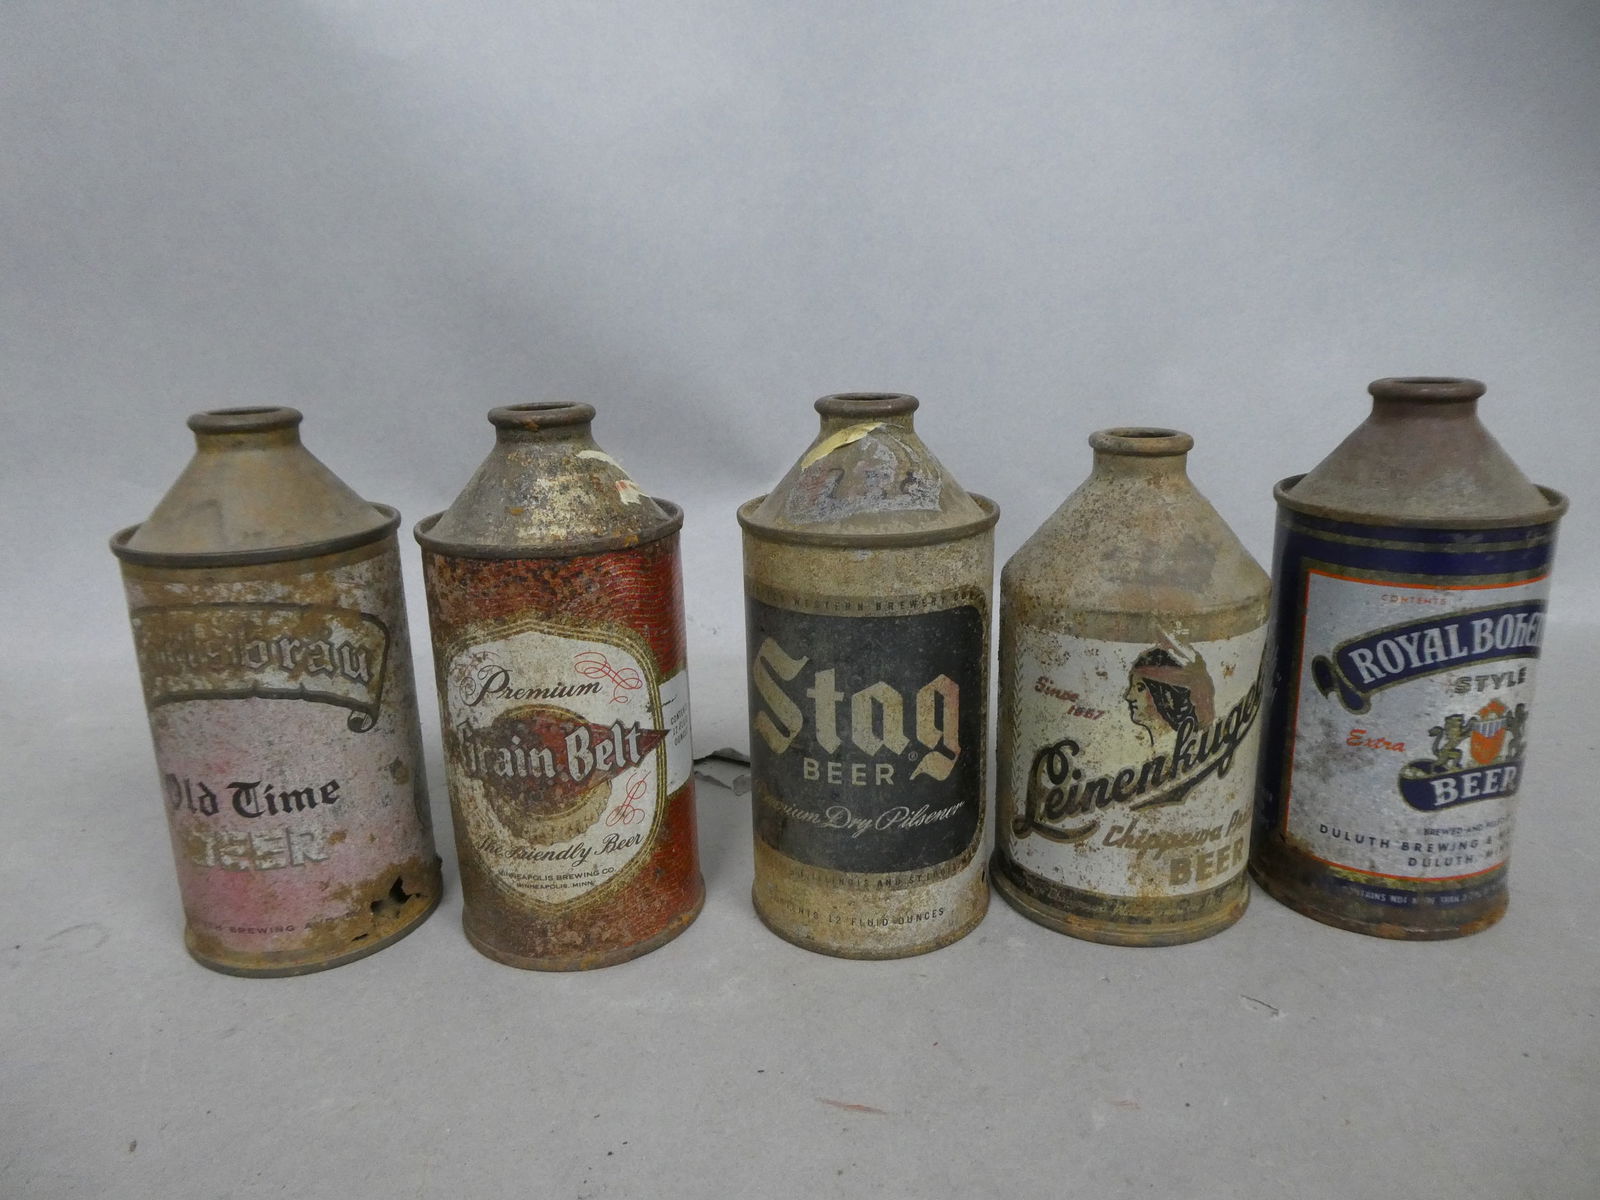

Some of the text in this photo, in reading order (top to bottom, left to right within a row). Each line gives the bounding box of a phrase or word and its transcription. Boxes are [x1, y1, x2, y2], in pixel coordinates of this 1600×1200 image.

[1348, 624, 1468, 684] ROYAL
[459, 665, 602, 707] Premium
[1454, 666, 1527, 694] STYLE
[753, 636, 961, 781] Stag
[564, 719, 645, 782] Belt
[1346, 729, 1406, 753] Extra
[803, 757, 894, 786] BEER
[1431, 766, 1517, 807] BEER
[226, 779, 340, 818] Time
[821, 805, 872, 838] Dry
[875, 800, 965, 831] Pilsener
[478, 832, 643, 867] The Friendly Beer
[1320, 824, 1390, 849] DULUTH
[1401, 838, 1479, 854] BREWING
[556, 871, 600, 881] BREWING
[601, 866, 617, 875] CO.
[1168, 837, 1244, 886] BEER
[229, 925, 296, 935] BREWING
[850, 917, 889, 928] FLUID
[898, 907, 945, 925] OUNCES
